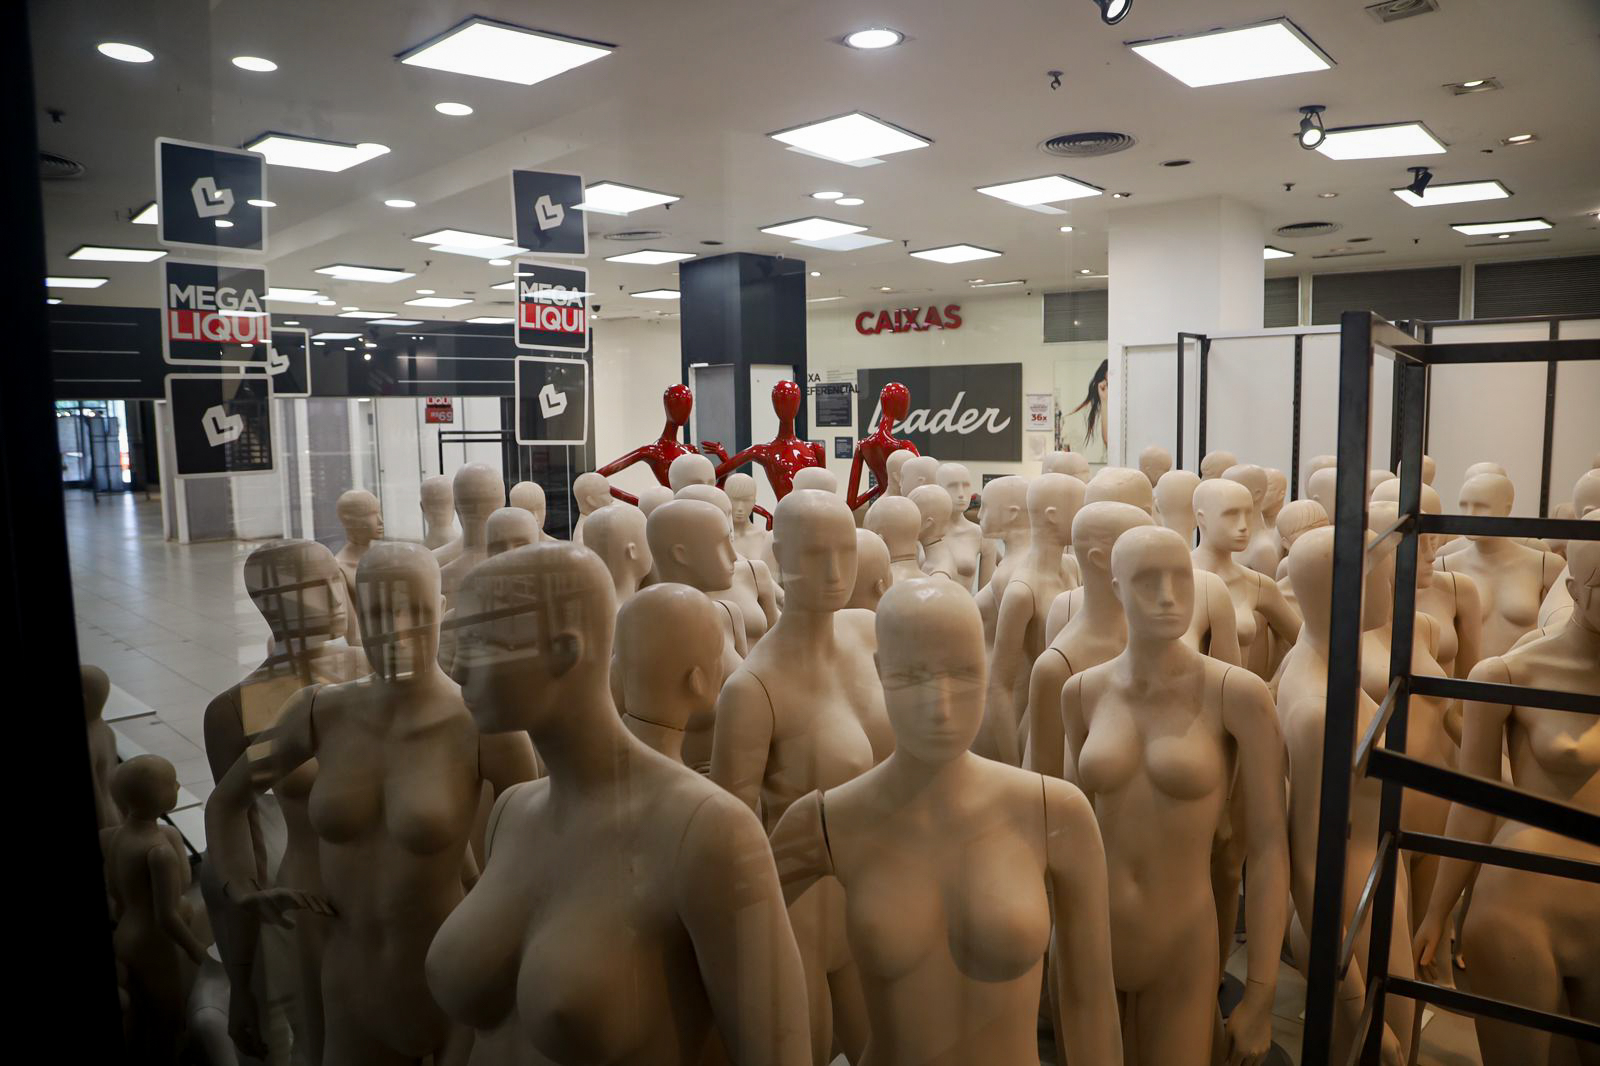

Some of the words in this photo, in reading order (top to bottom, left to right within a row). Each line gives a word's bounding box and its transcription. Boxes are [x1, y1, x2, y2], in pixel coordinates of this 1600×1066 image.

[169, 283, 262, 312] MEGA
[520, 281, 583, 308] MEGA
[170, 310, 264, 343] LIQUI
[520, 303, 584, 333] LIQUI
[855, 304, 963, 336] CAIXAS
